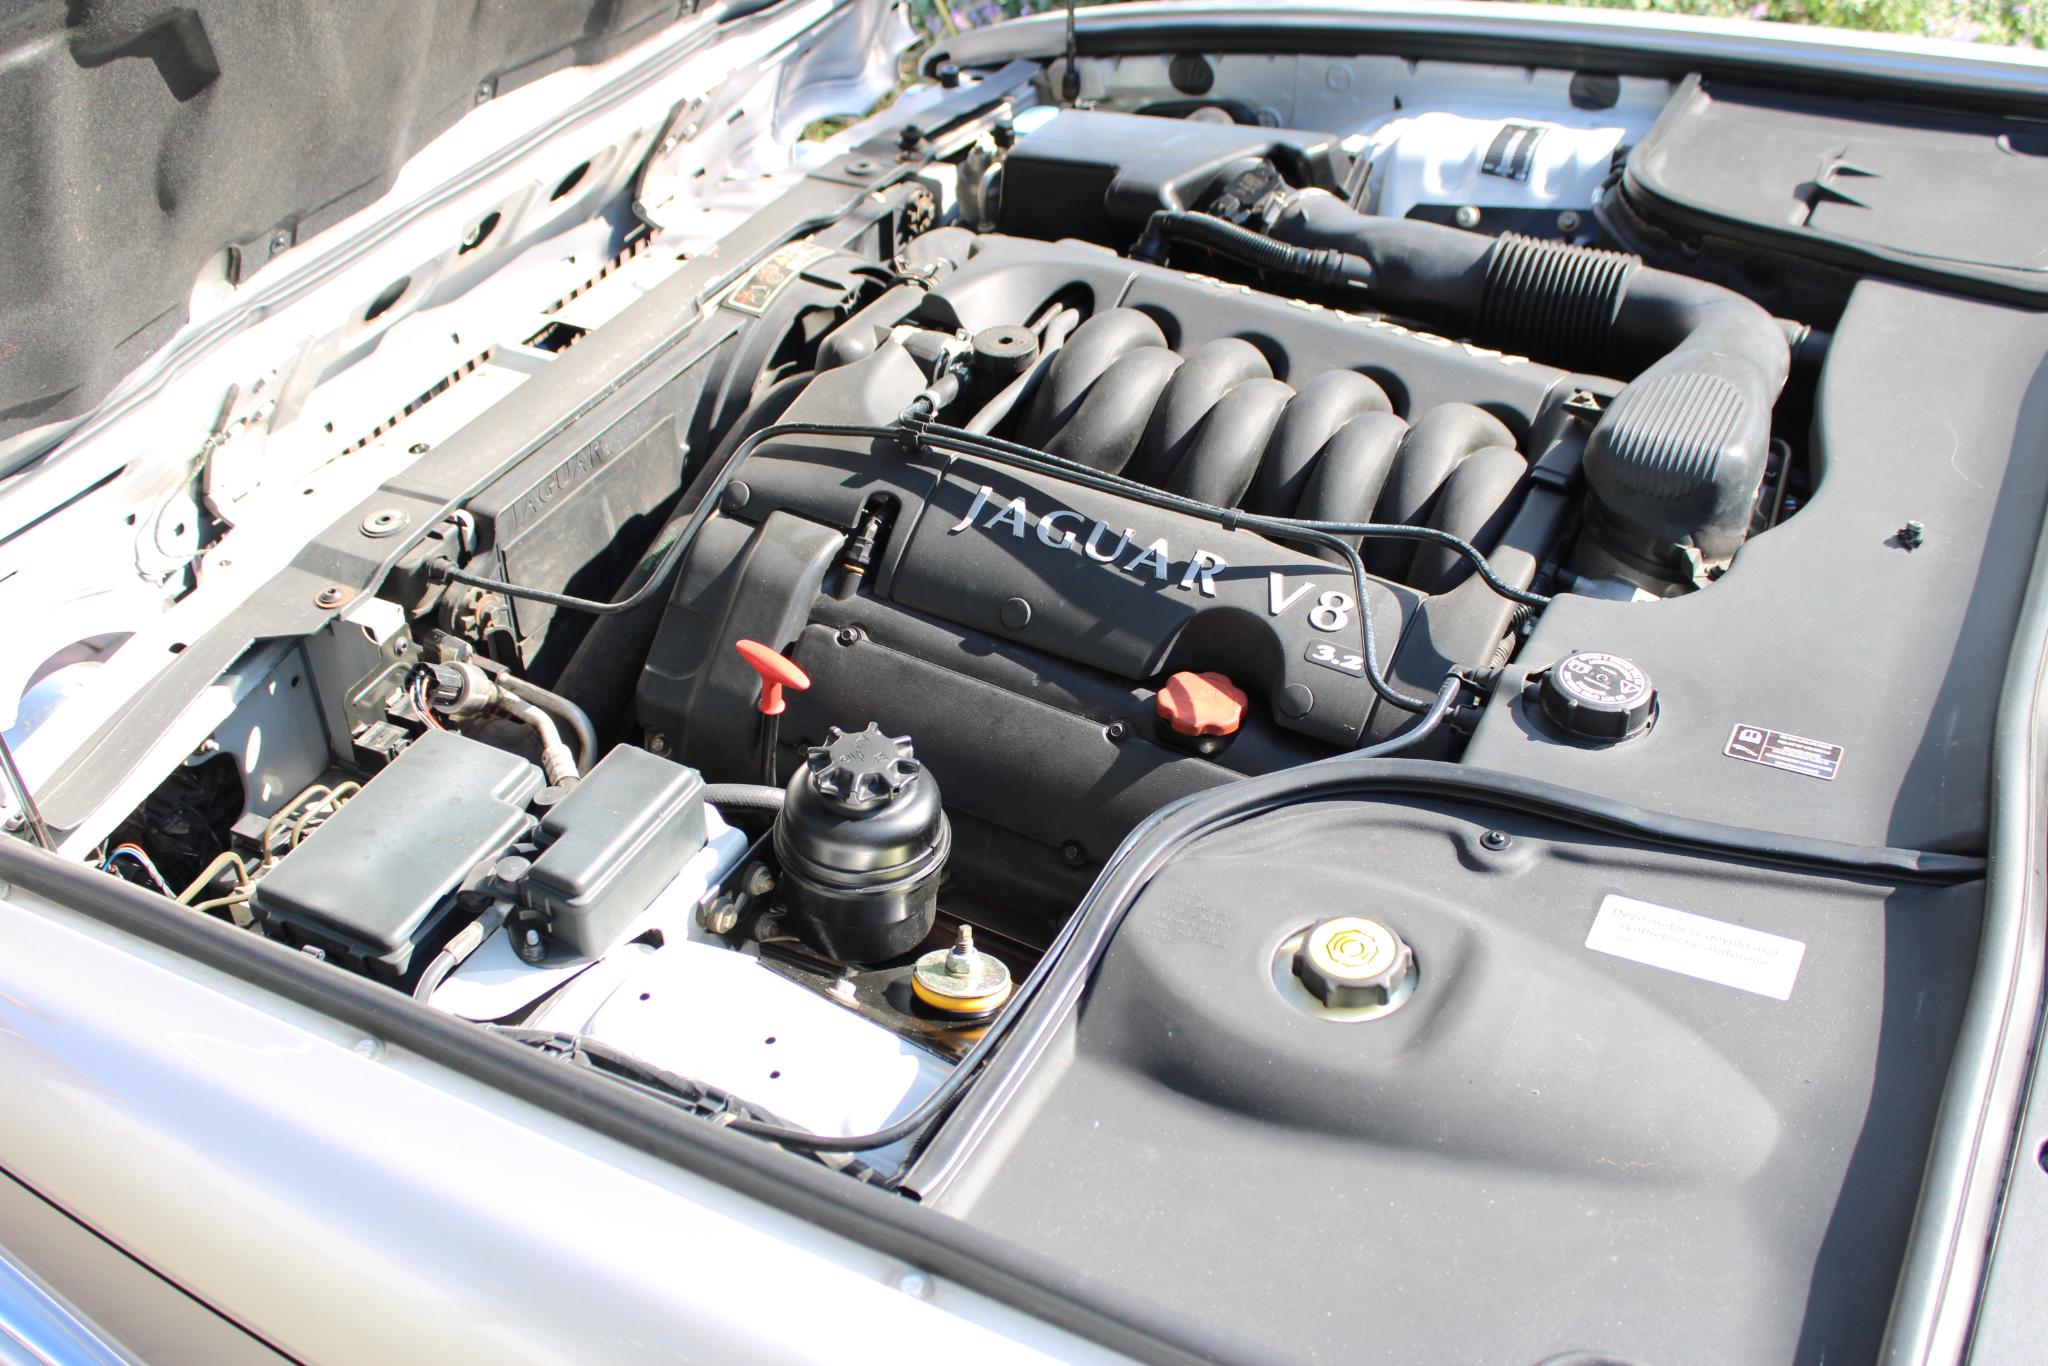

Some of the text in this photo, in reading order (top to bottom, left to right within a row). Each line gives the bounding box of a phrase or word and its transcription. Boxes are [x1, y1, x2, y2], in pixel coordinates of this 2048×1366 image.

[511, 439, 604, 533] JAGUAR
[947, 485, 1227, 598] JAGUAR
[1268, 571, 1355, 632] V8
[1311, 644, 1365, 671] 3.2
